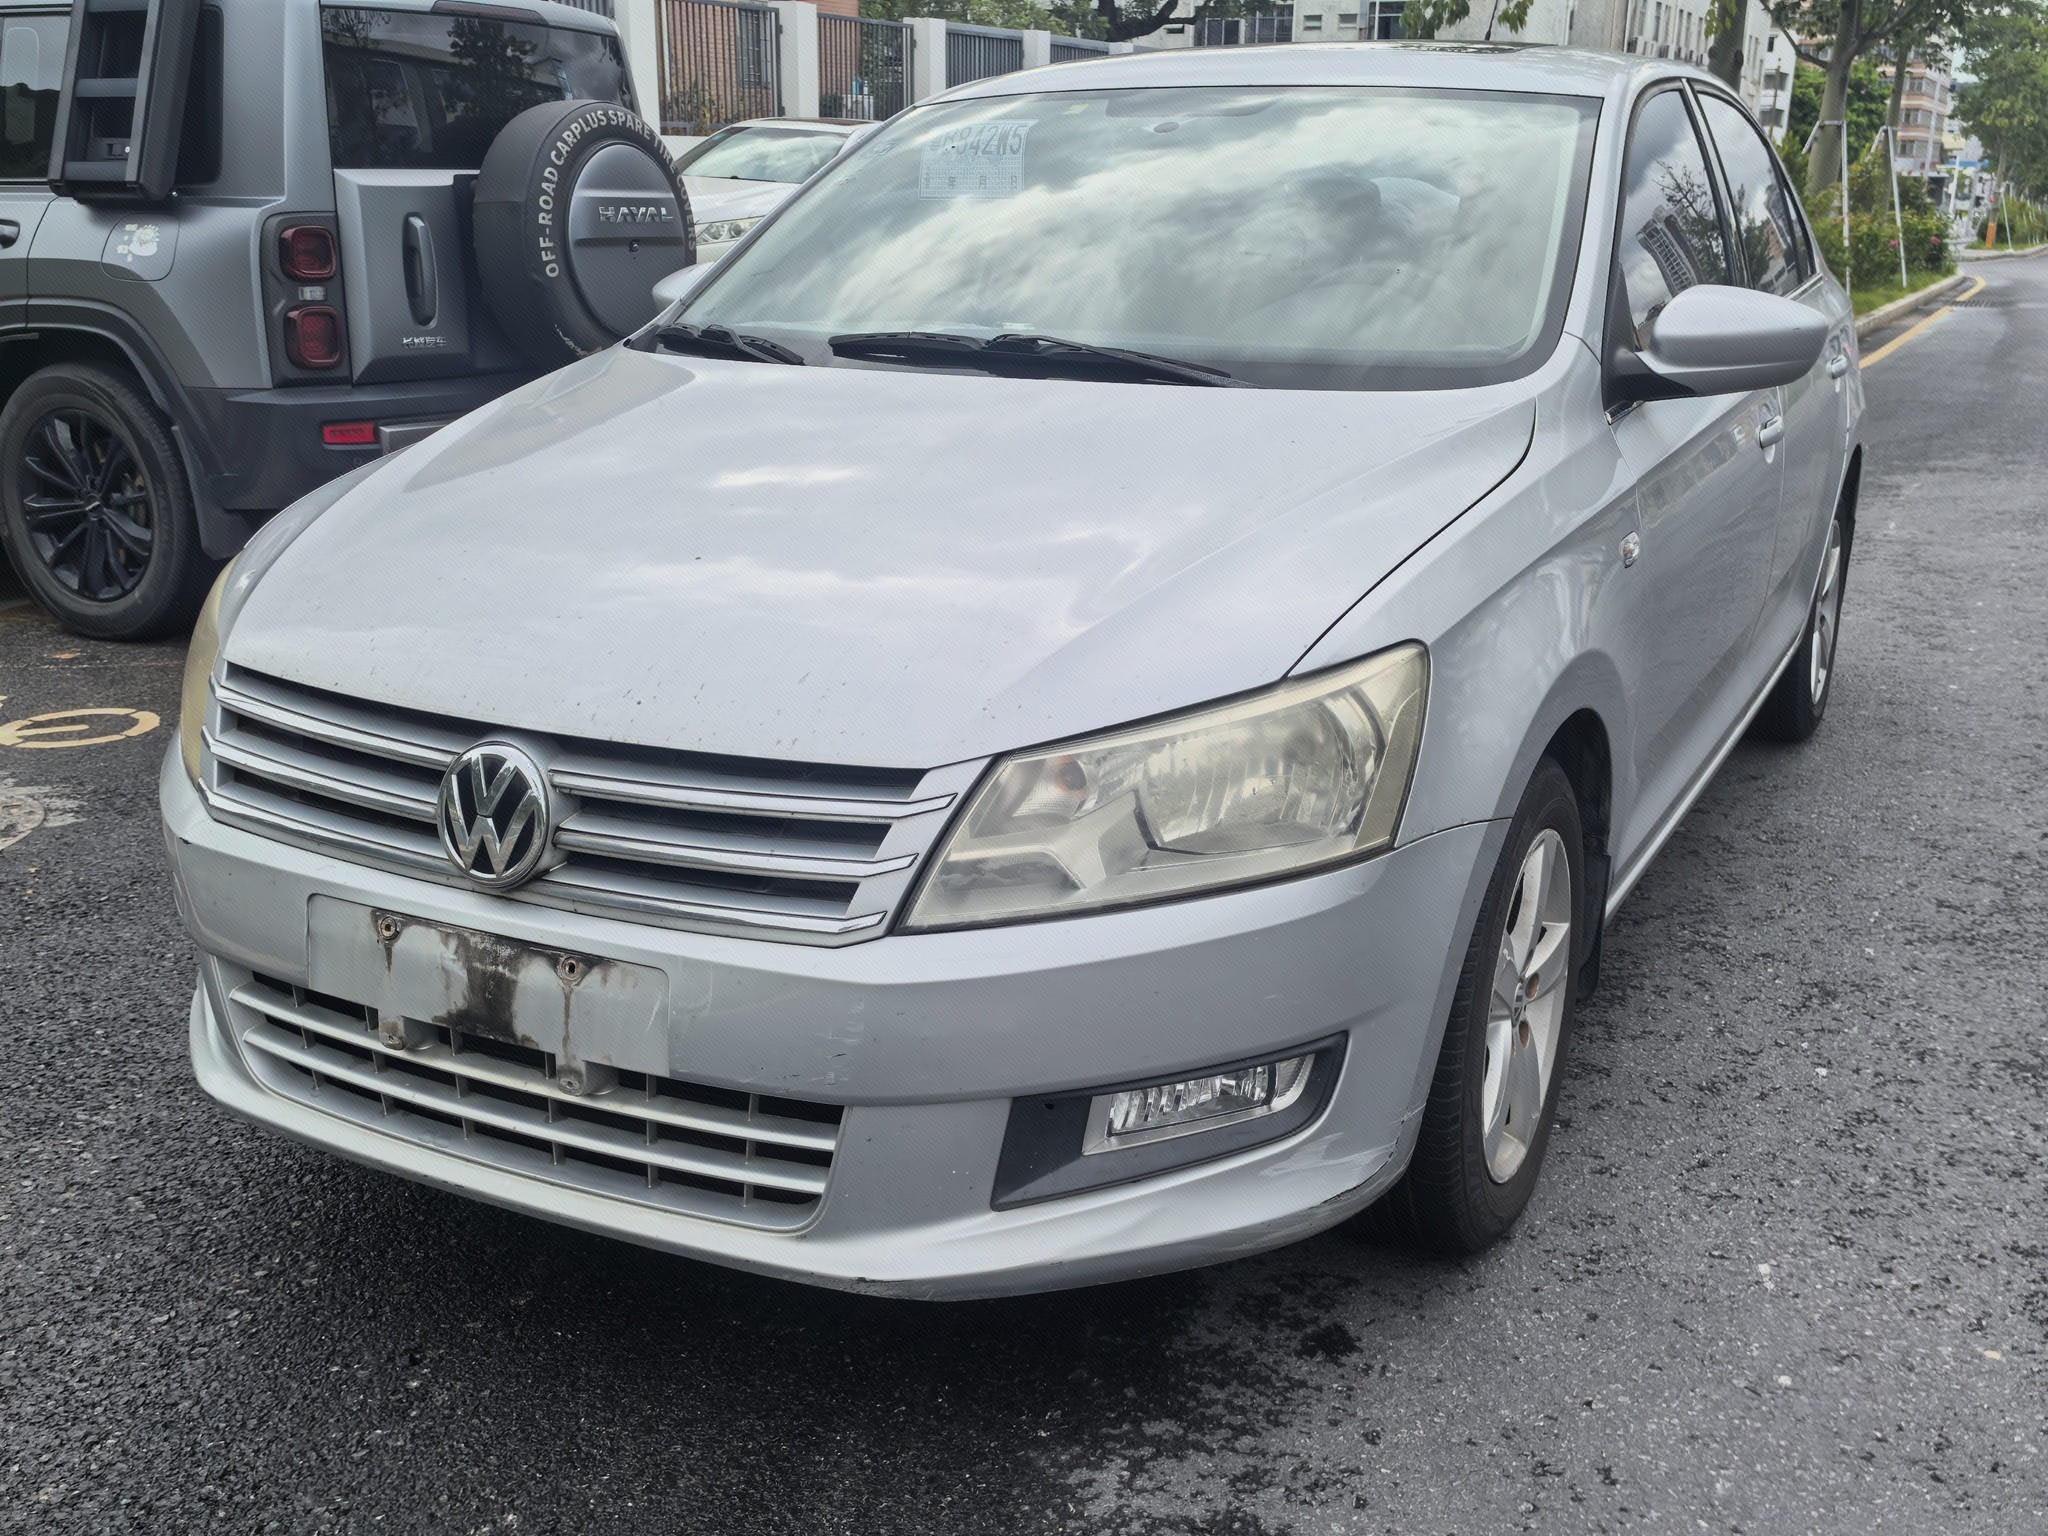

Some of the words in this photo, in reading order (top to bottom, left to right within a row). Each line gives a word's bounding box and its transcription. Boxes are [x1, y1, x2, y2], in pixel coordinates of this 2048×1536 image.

[538, 166, 559, 278] OFF-ROAD
[550, 110, 607, 166] CARPLUS
[608, 109, 651, 141] SPARE
[651, 132, 677, 174] TIRE
[676, 173, 697, 252] COVERS
[598, 206, 674, 224] HAVAL
